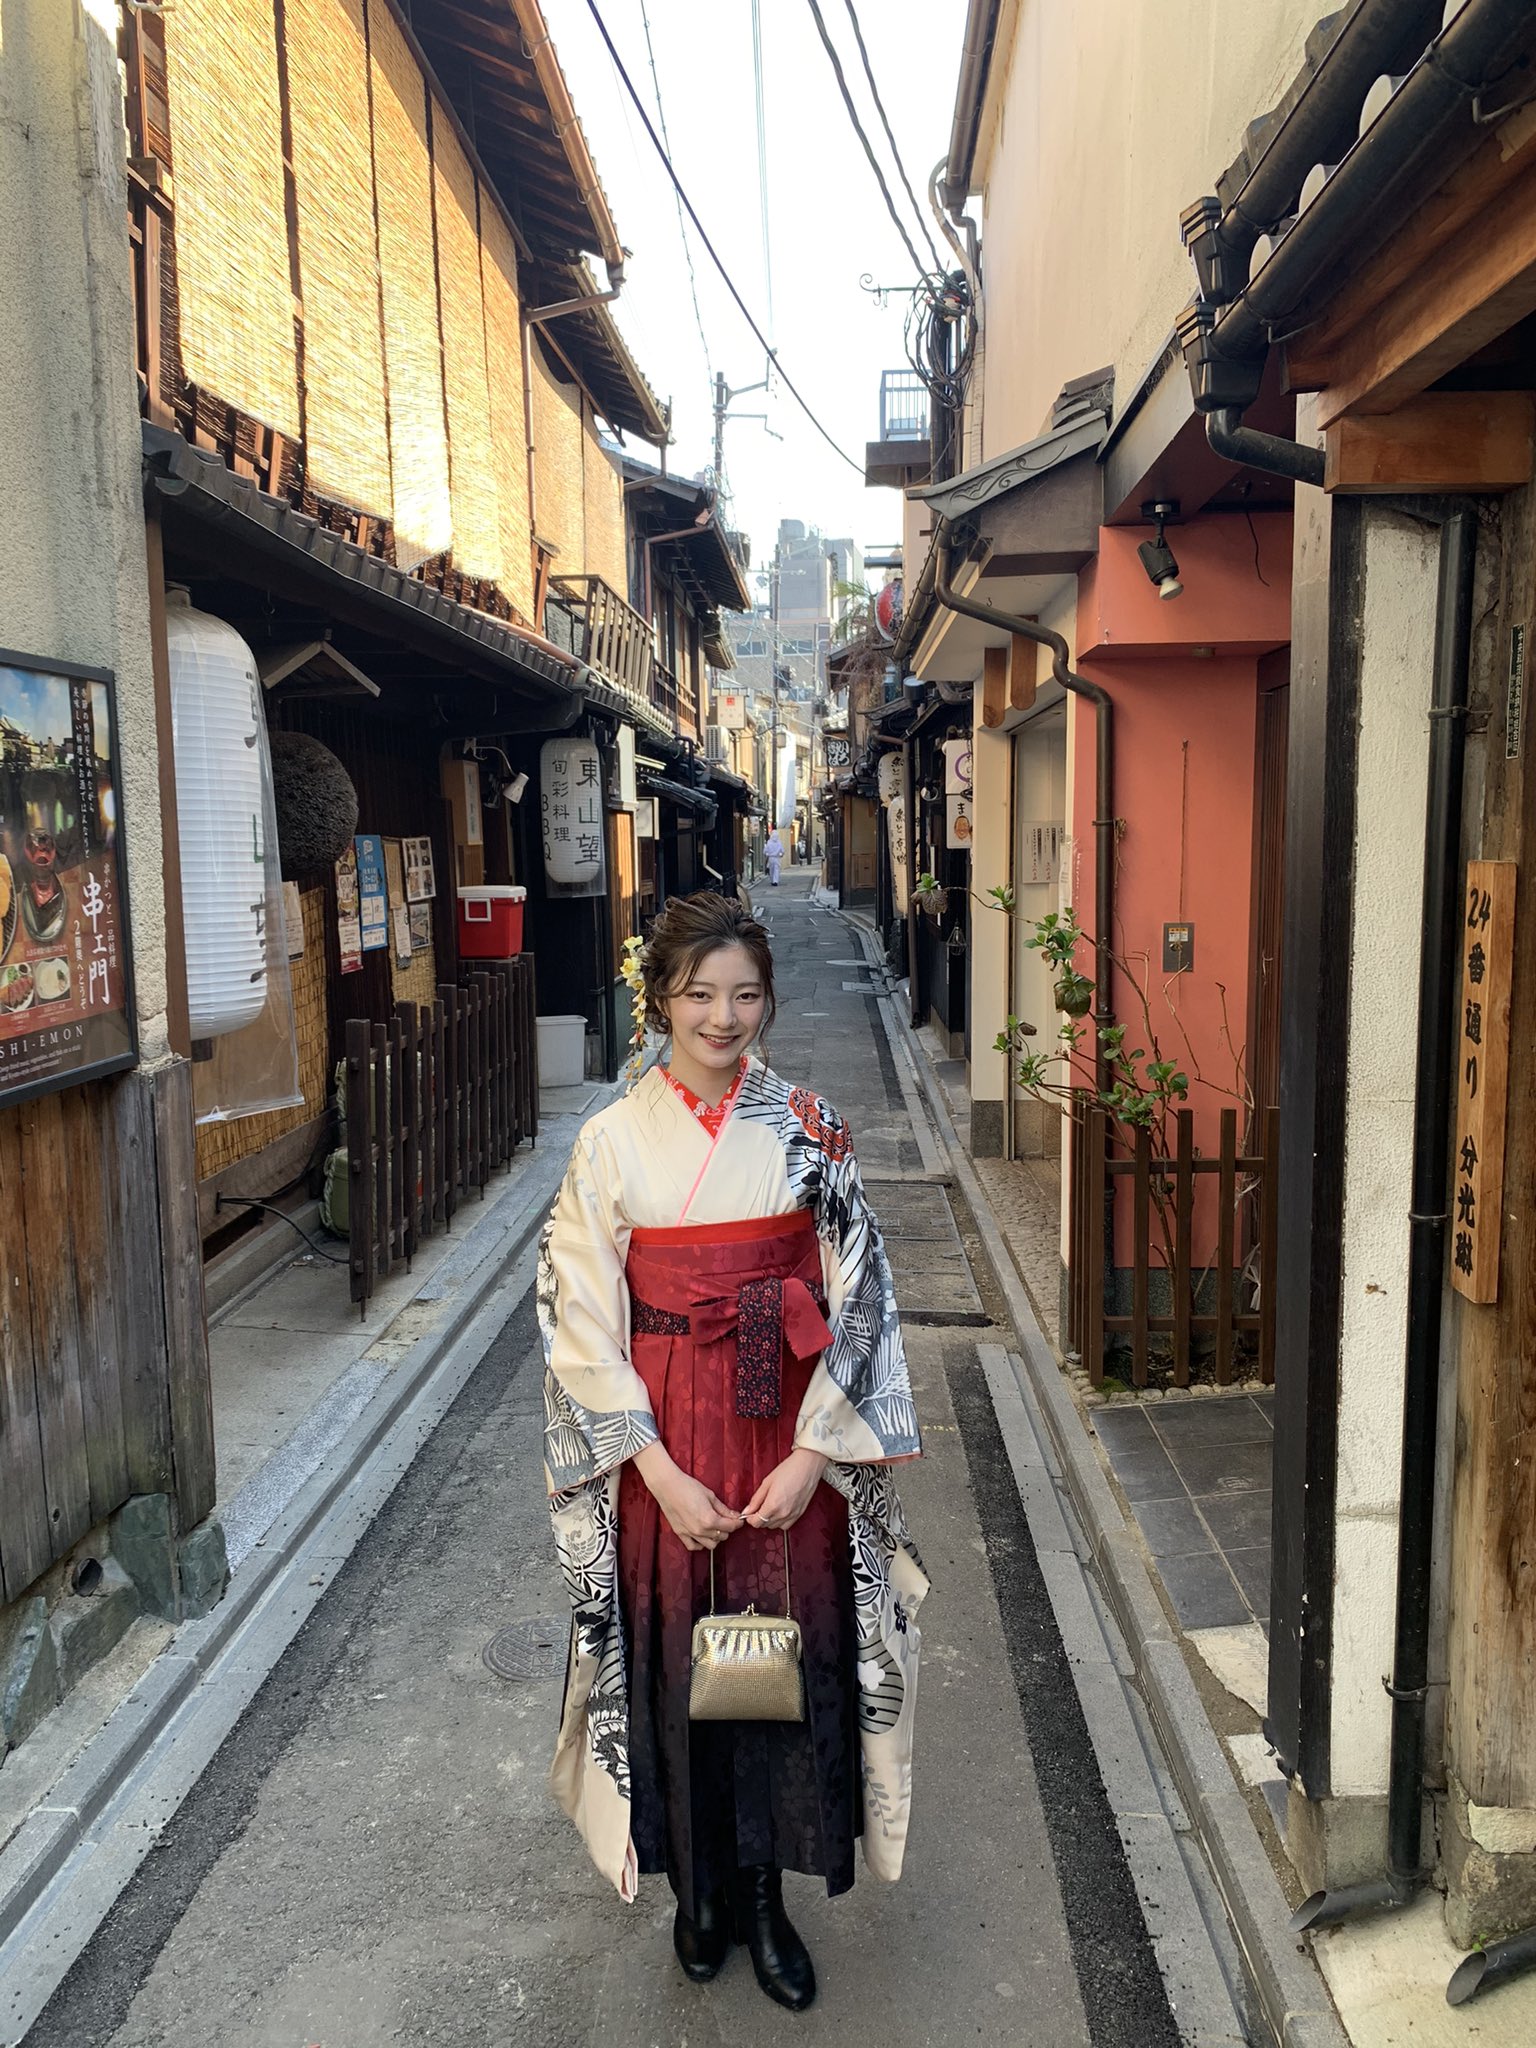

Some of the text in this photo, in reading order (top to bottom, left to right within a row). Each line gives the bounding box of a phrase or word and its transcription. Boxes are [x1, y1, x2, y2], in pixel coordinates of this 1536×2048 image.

[552, 760, 571, 842] 旬彩料理
[575, 757, 601, 865] 東山望
[1465, 887, 1491, 1100] 24番通り
